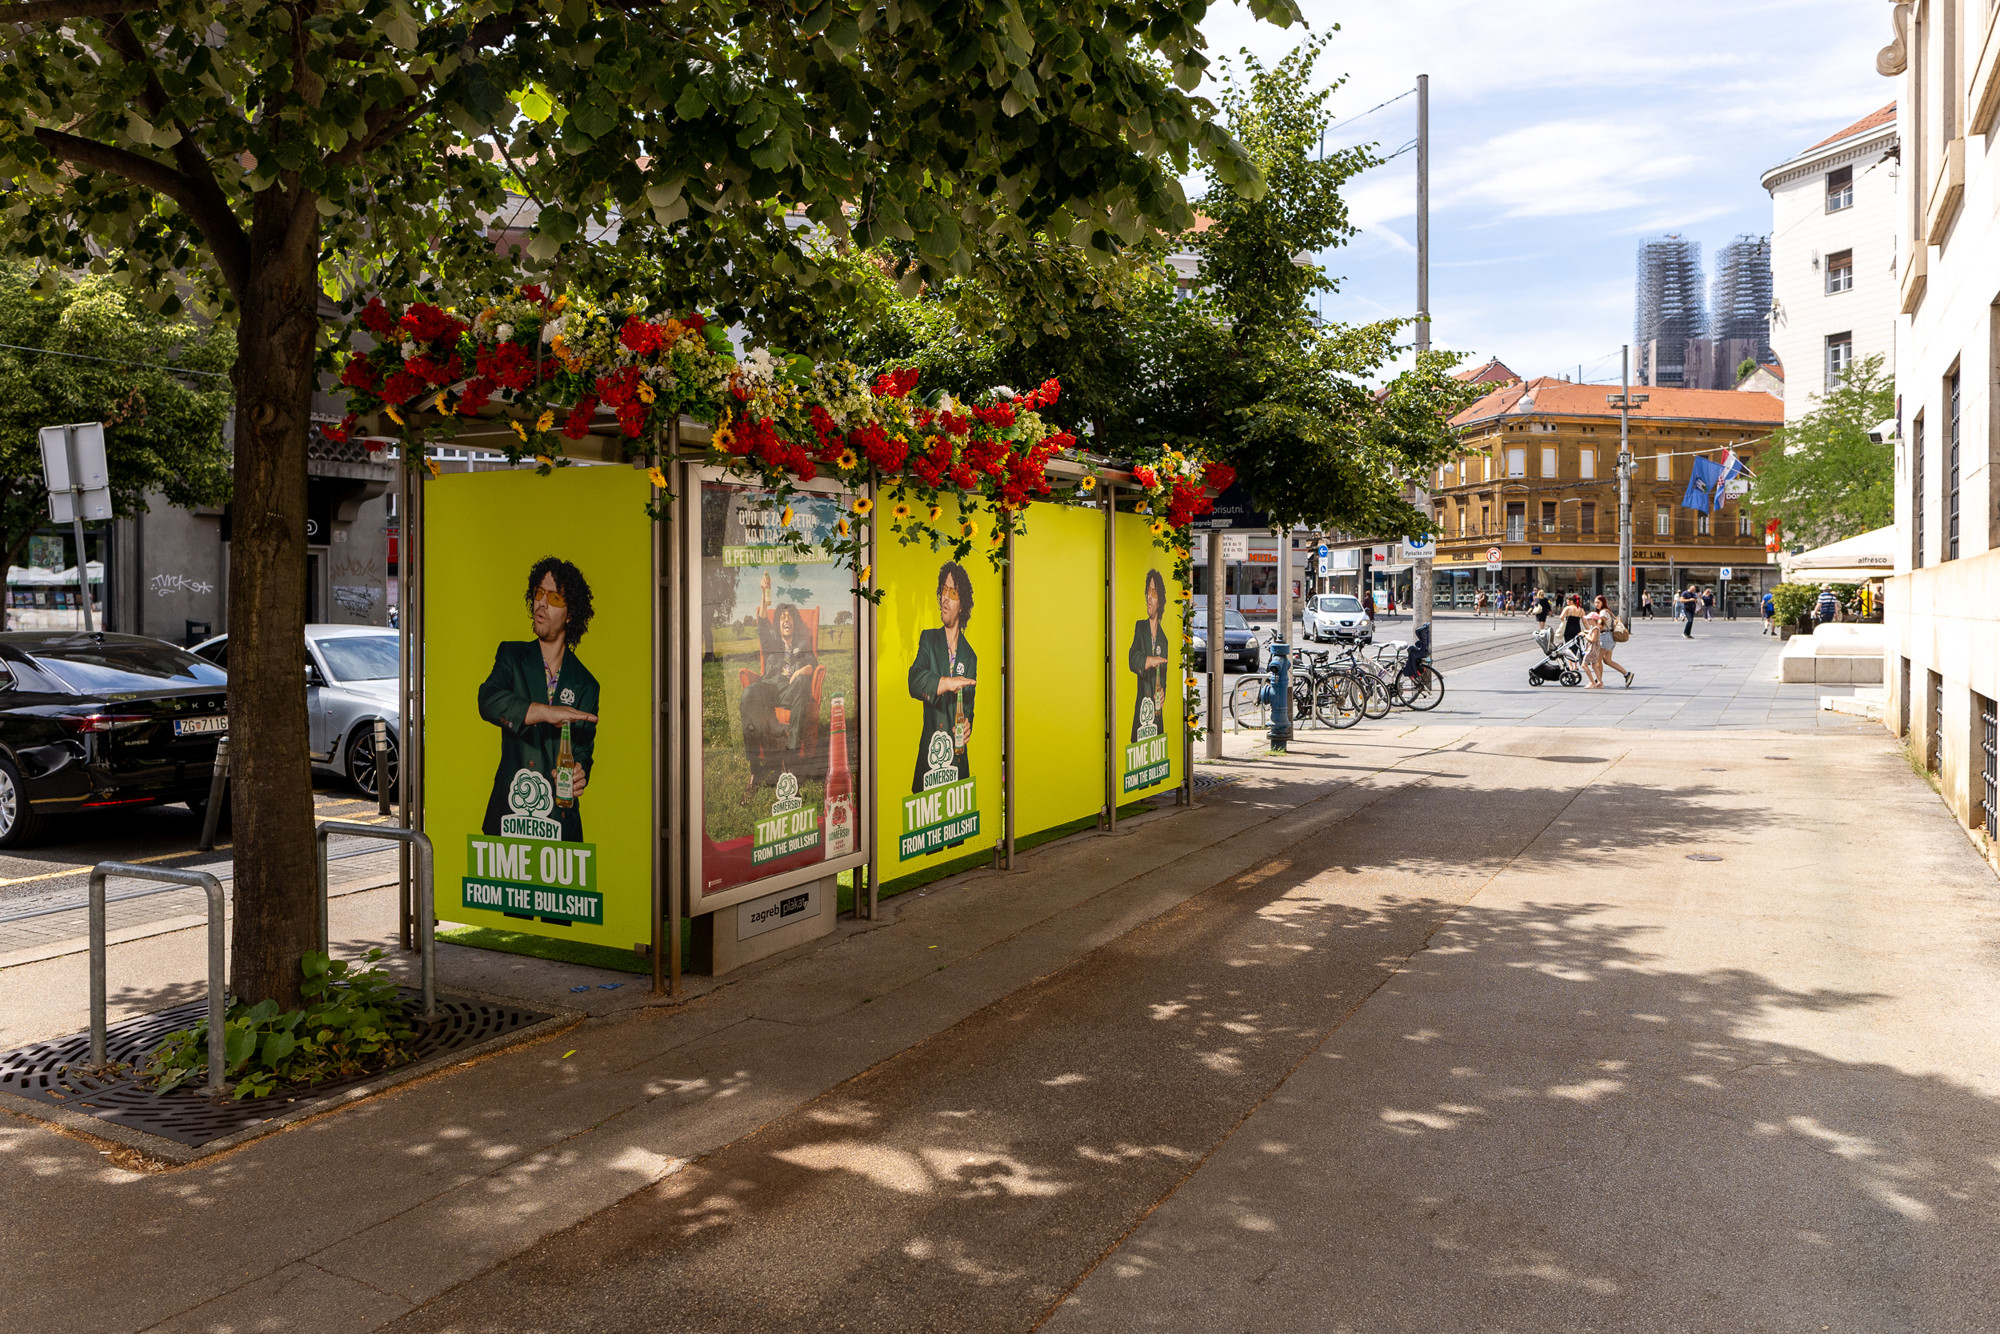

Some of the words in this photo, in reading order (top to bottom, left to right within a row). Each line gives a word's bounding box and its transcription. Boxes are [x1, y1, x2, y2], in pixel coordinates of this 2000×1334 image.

[738, 510, 757, 526] OVO
[758, 511, 769, 526] JE
[1212, 505, 1244, 515] prisutni.
[745, 528, 765, 543] KOJI
[724, 549, 731, 564] O
[733, 549, 761, 564] PETKU
[763, 549, 775, 563] OD
[1248, 553, 1278, 562] Mülle
[1650, 551, 1666, 559] LINE
[1858, 556, 1887, 564] alfresco
[182, 720, 196, 733] ZG
[1127, 742, 1148, 771] TIME
[1150, 736, 1167, 763] OUT
[924, 769, 957, 788] SOMERSBY
[1125, 773, 1139, 790] FROM
[1139, 770, 1148, 784] THE
[1148, 762, 1169, 781] BULLSHIT
[773, 799, 801, 814] SOMERSBY
[905, 791, 942, 831] TIME
[946, 781, 974, 818] OUT
[503, 818, 560, 840] SOMERSBY
[757, 815, 788, 845] TIME
[791, 807, 816, 834] OUT
[902, 832, 926, 856] FROM
[926, 827, 942, 847] THE
[943, 815, 978, 842] BULLSHIT
[753, 847, 774, 863] FROM
[774, 842, 787, 856] THE
[788, 832, 819, 852] BULLSHIT
[471, 840, 533, 882] TIME
[540, 846, 592, 887] OUT
[466, 883, 502, 906] FROM
[505, 887, 531, 909] THE
[534, 891, 598, 918] BULLSHIT
[751, 904, 780, 923] zagreb
[782, 895, 808, 916] plakat
